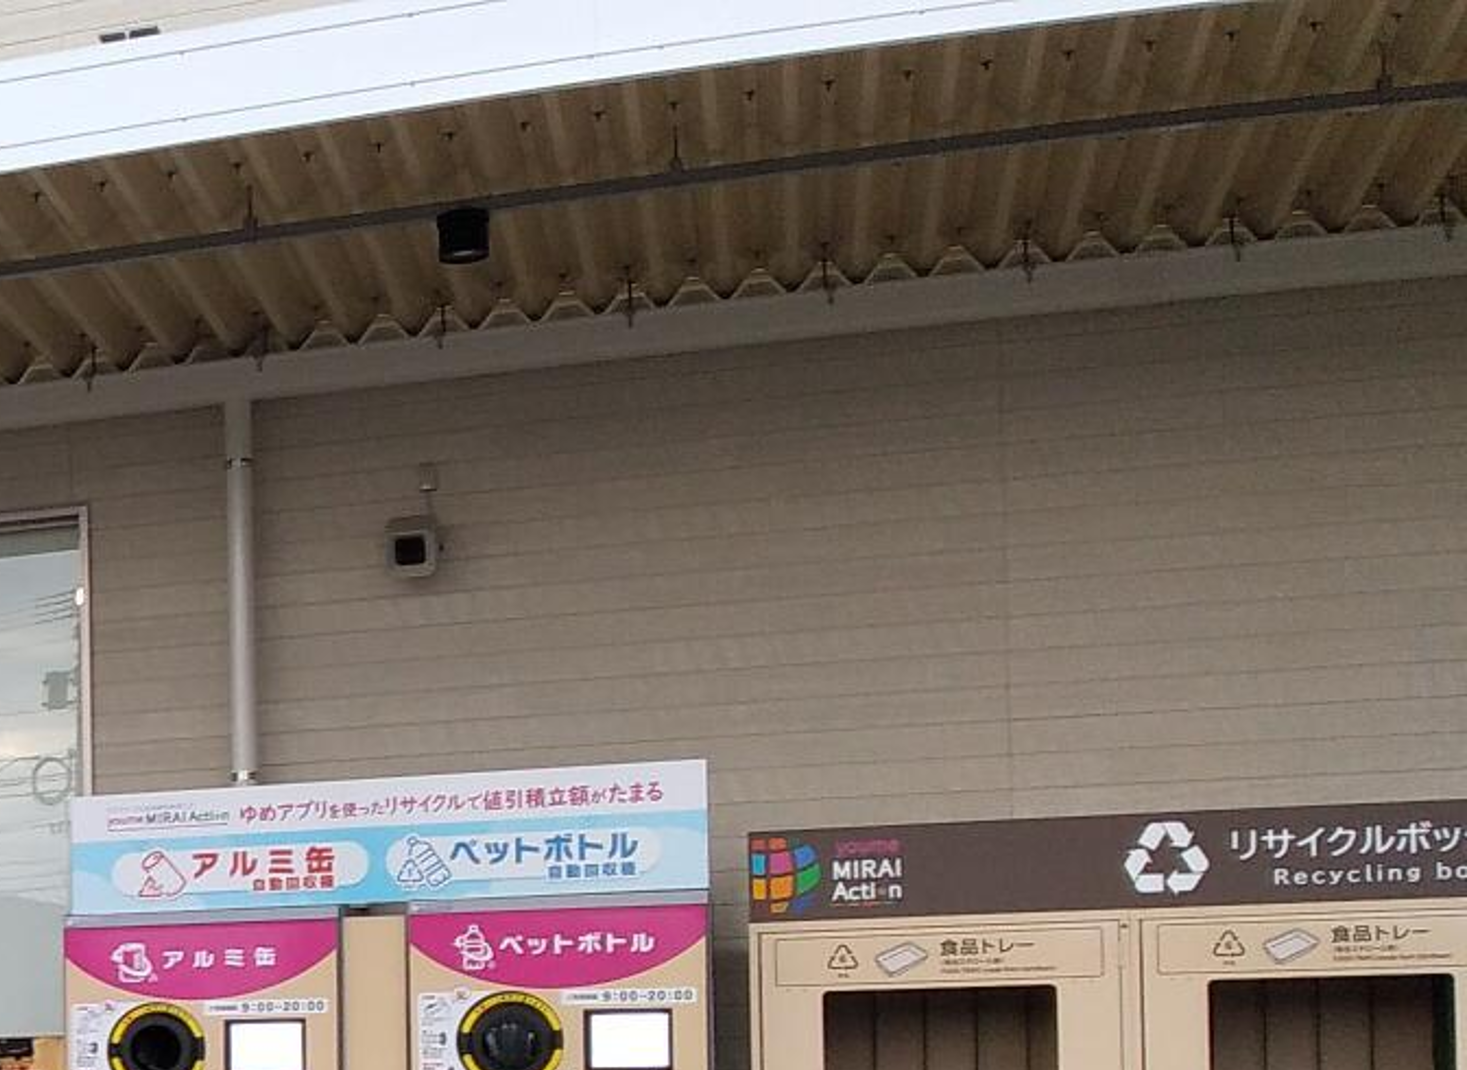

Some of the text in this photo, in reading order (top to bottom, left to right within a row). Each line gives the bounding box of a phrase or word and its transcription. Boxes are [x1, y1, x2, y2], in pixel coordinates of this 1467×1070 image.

[239, 780, 664, 822] ゆめアプリを使ったリサイクルで値引積立額がたまる
[449, 833, 639, 865] ペットボトル
[1230, 820, 1467, 861] リサイクルボッ
[191, 846, 335, 878] アルミ缶
[832, 858, 902, 880] MIRAI
[1273, 864, 1421, 885] Recycling
[498, 931, 655, 956] ペットボトル
[1331, 925, 1430, 943] 食品トレー
[161, 946, 277, 969] アルミ缶
[939, 938, 1035, 957] 食品トレー
